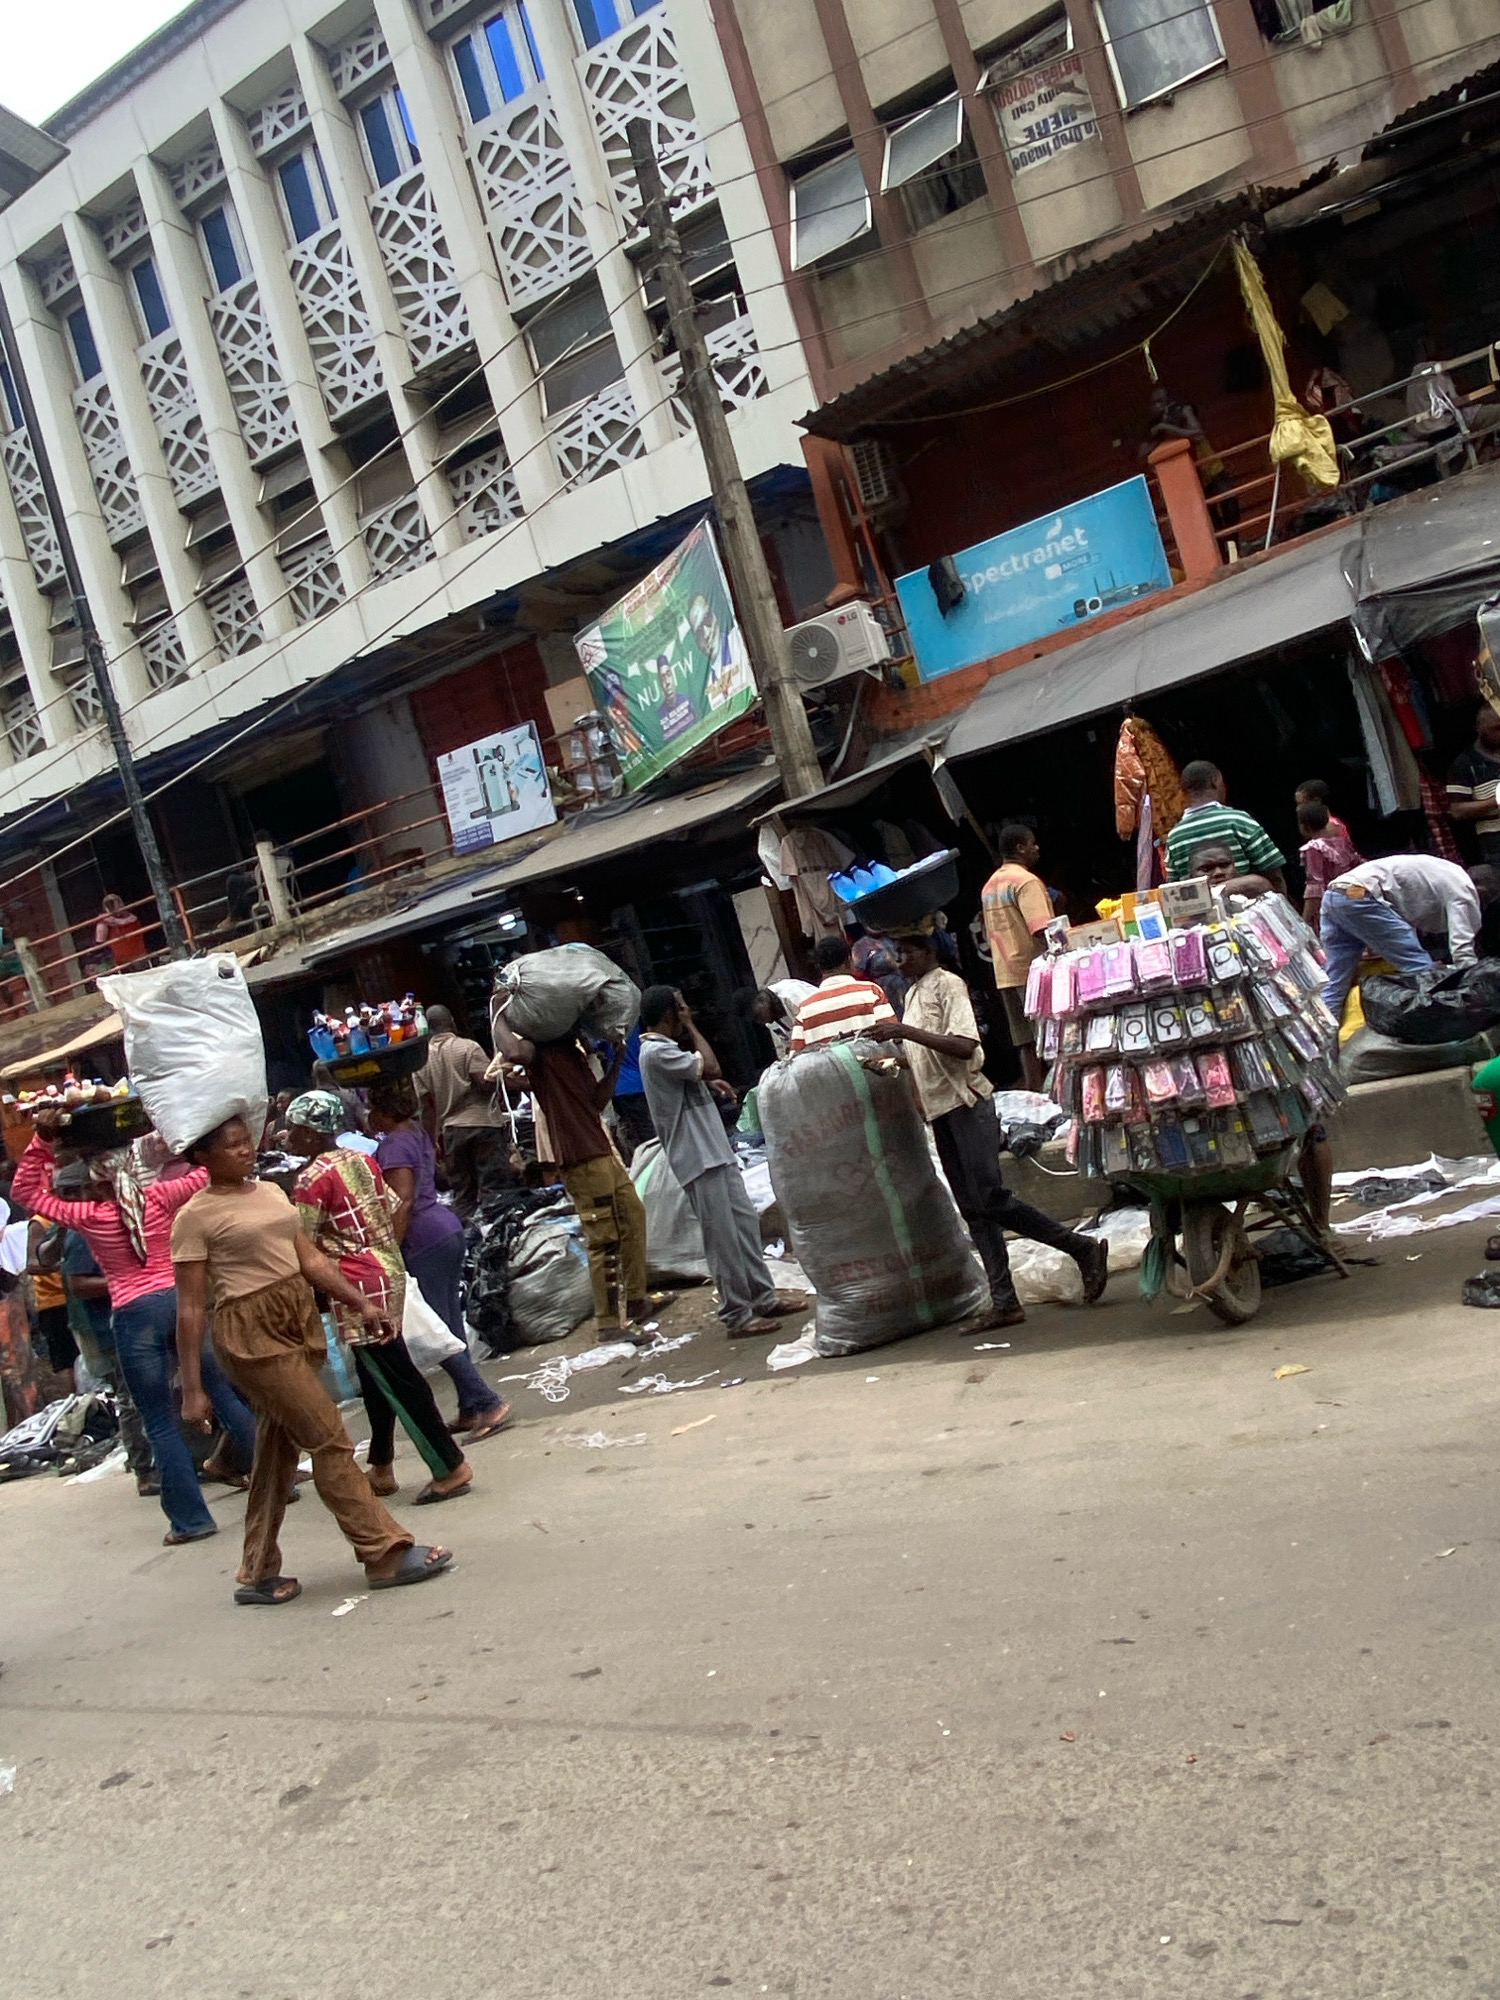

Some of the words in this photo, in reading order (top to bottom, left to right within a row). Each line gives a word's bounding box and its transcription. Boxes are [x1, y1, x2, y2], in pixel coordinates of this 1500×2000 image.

[1012, 101, 1035, 120] Call
[1022, 106, 1078, 140] HERE
[1052, 126, 1083, 150] Drop
[1013, 141, 1052, 170] Image
[959, 528, 1088, 594] Spectranet
[847, 612, 857, 621] LG
